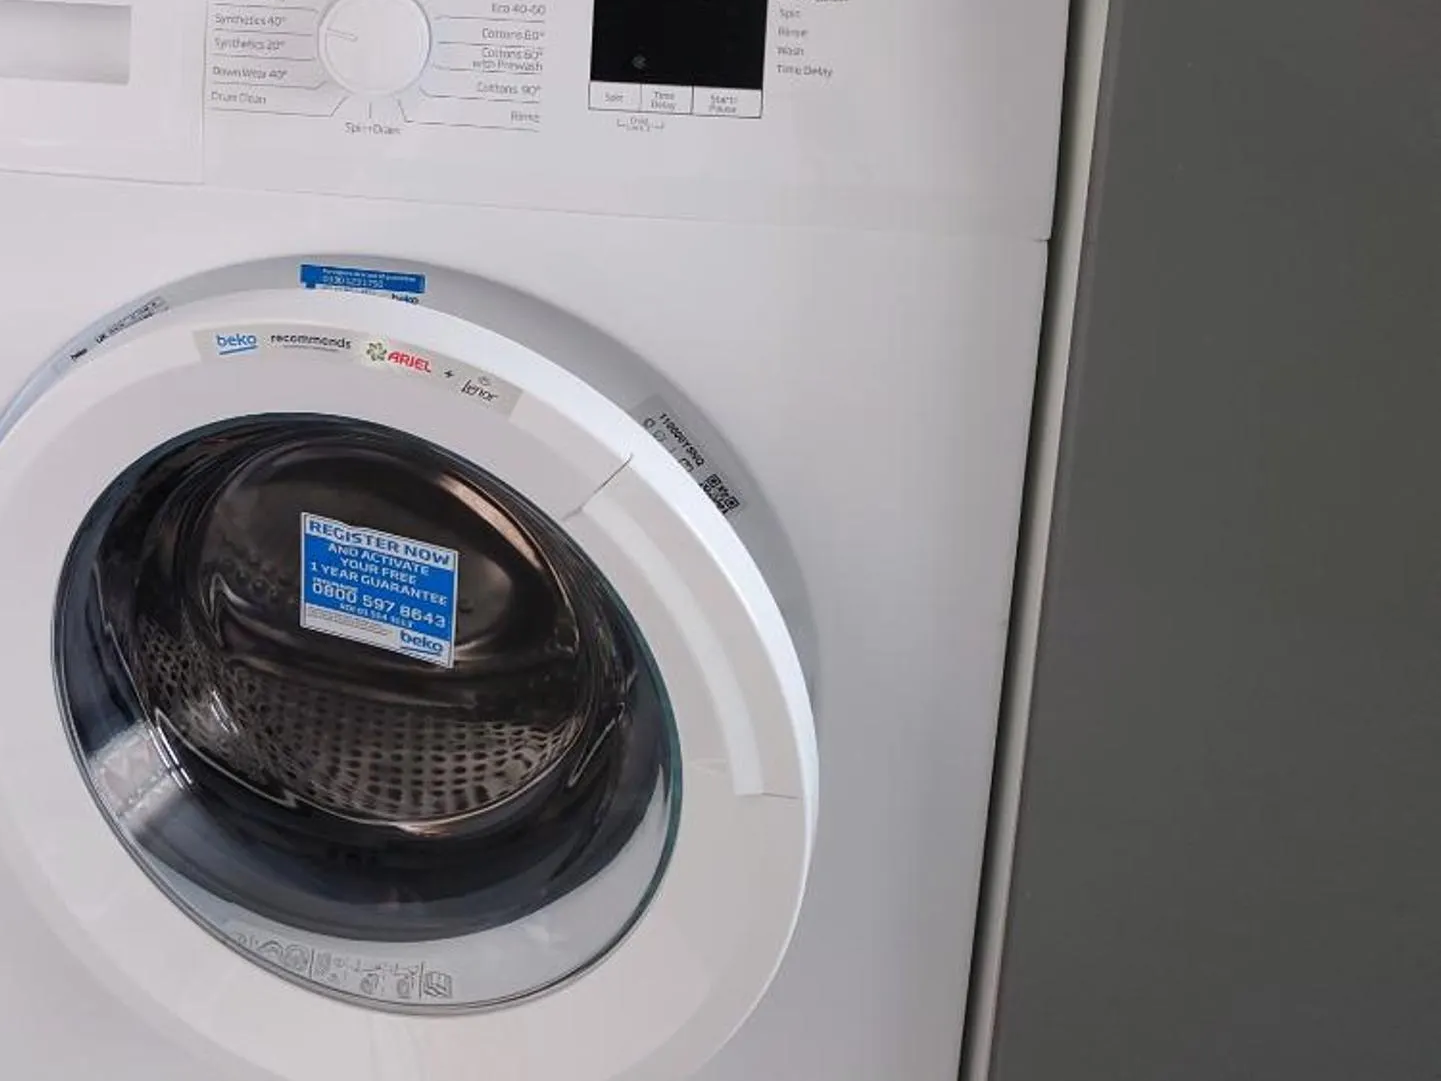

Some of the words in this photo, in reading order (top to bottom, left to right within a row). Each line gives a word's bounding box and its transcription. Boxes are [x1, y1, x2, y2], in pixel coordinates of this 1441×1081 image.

[216, 334, 257, 347] beko
[270, 333, 352, 350] recommends
[387, 351, 432, 373] ARIEL
[311, 521, 401, 554] REGISTER
[404, 544, 451, 566] NOW
[328, 544, 358, 558] AND
[360, 548, 430, 576] ACTIVATE
[311, 562, 318, 571] 1
[319, 565, 359, 582] YEAR
[360, 574, 448, 606] GUARANTEE
[340, 556, 379, 575] YOUR
[382, 568, 418, 585] FREE
[312, 583, 358, 604] 0800
[362, 594, 396, 614] 597
[399, 605, 446, 628] 8643
[400, 630, 444, 654] beko
